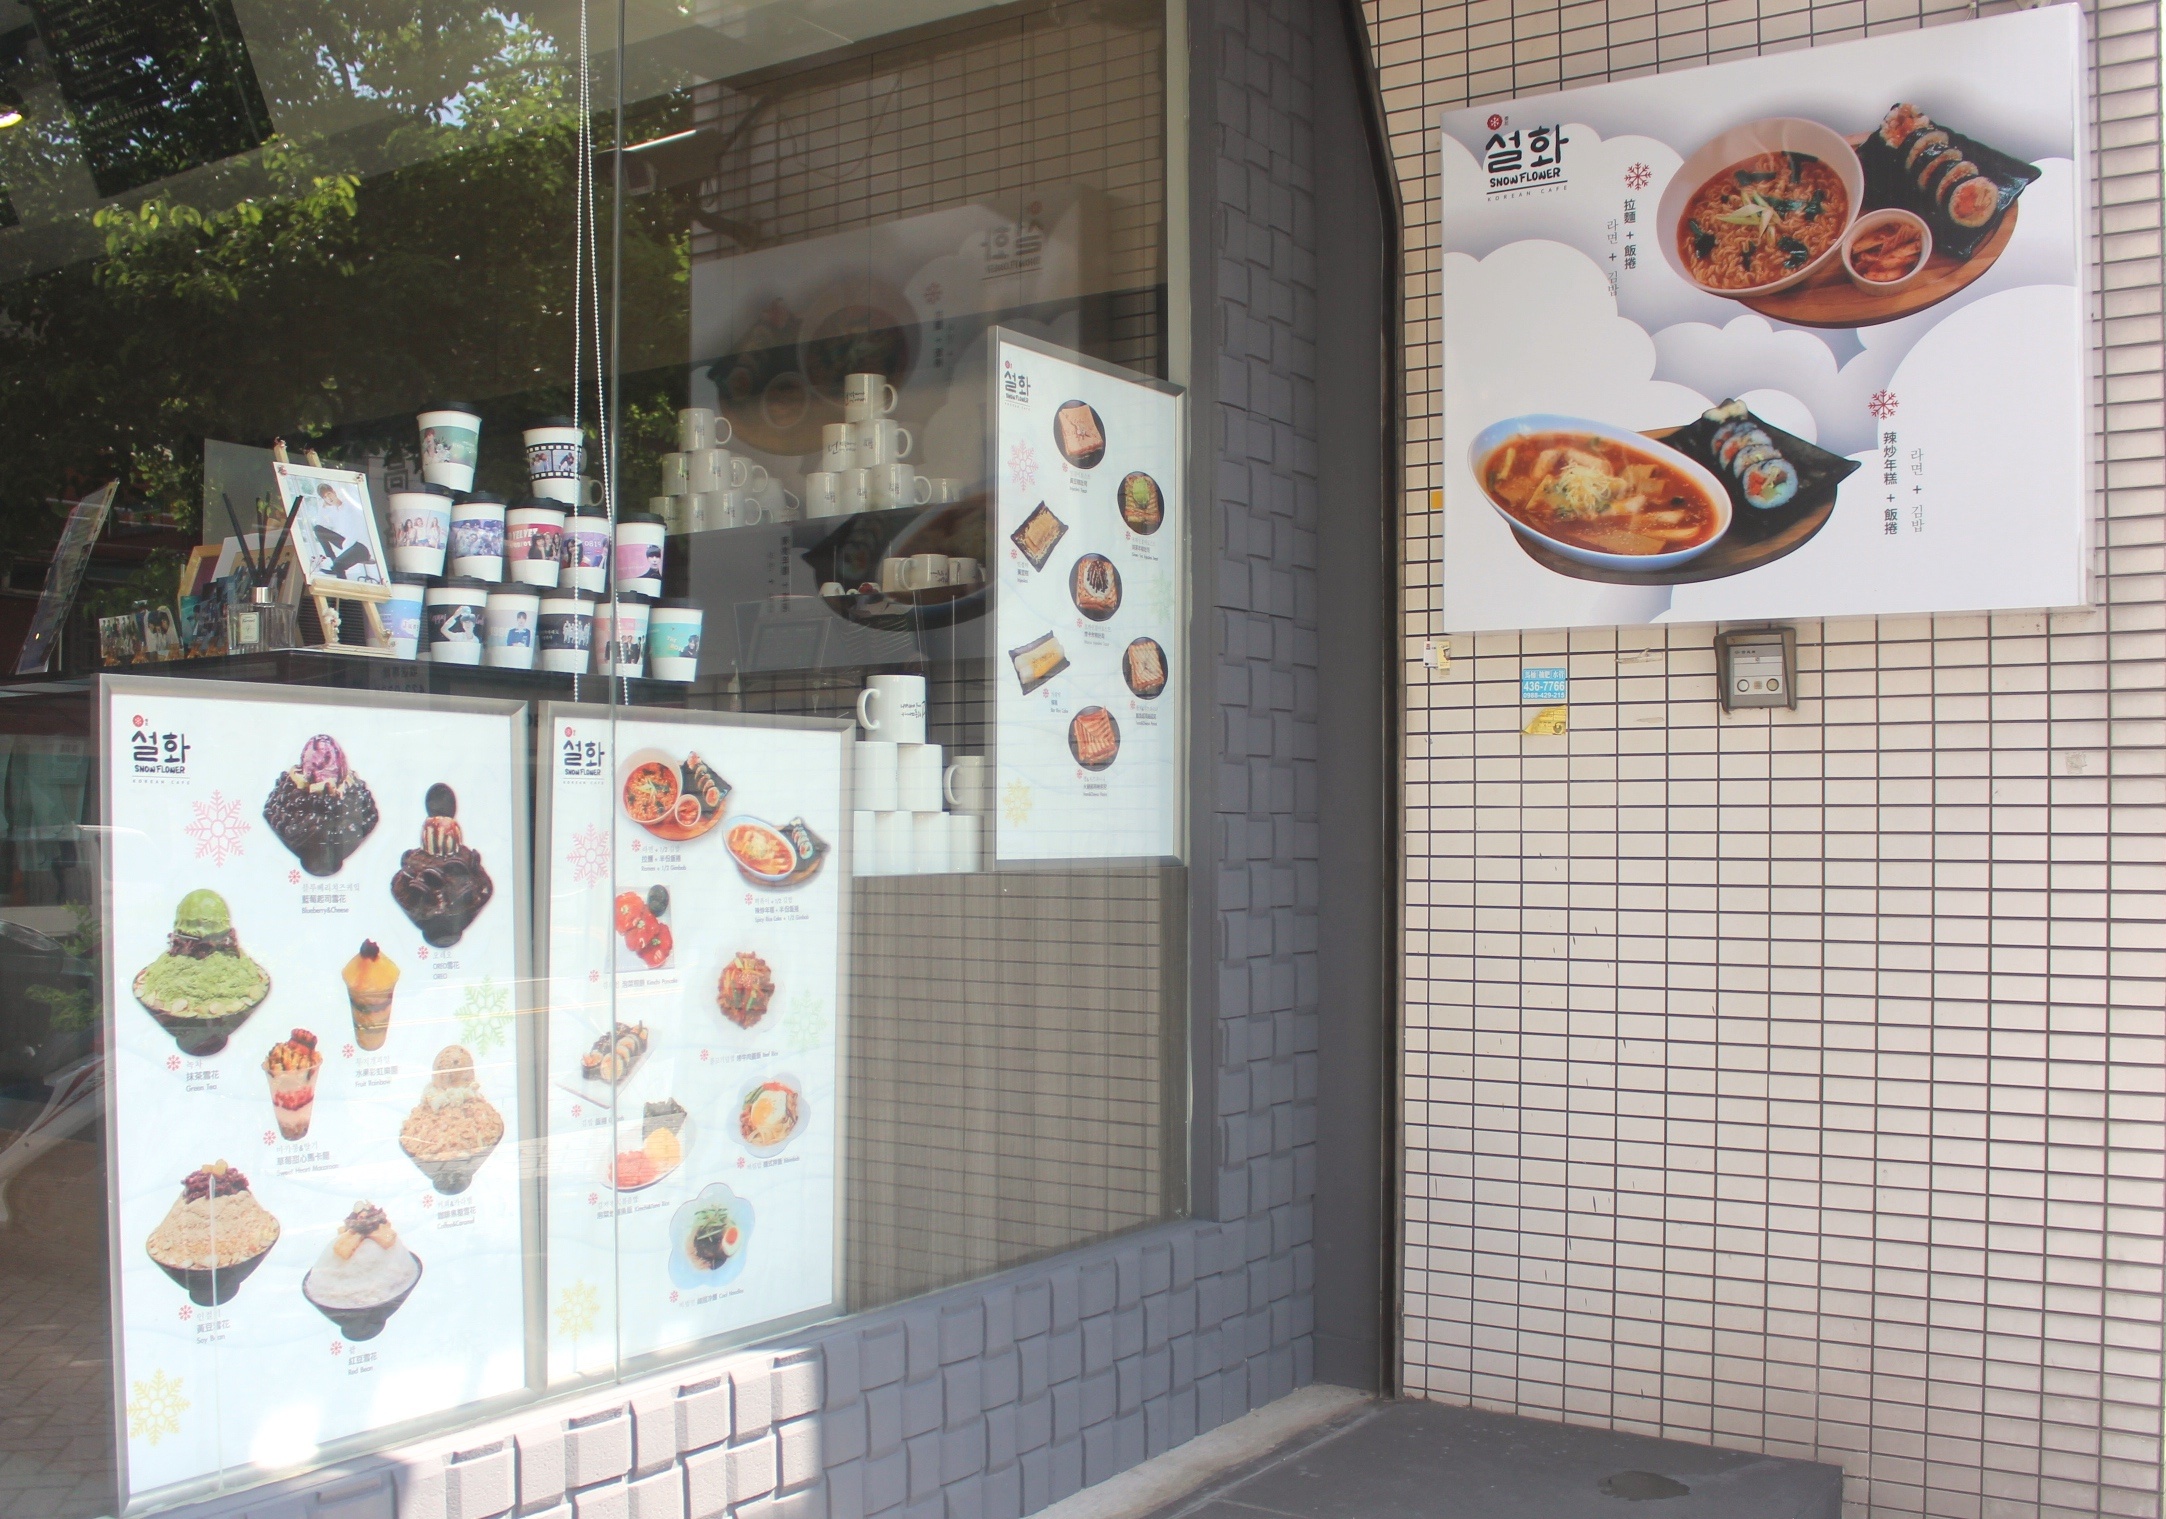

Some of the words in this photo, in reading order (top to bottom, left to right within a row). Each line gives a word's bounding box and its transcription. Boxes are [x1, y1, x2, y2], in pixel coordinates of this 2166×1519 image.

[1486, 124, 1569, 173] 설화
[1490, 175, 1519, 188] SNOW
[1519, 167, 1561, 183] FLOWER
[1487, 191, 1531, 202] KOREAN
[1541, 185, 1568, 195] CAFE
[1624, 199, 1636, 224] 拉麵
[1607, 219, 1618, 245] 라면
[1624, 244, 1637, 270] 飯捲
[1608, 270, 1620, 297] 김밥
[1004, 370, 1031, 397] 설화
[1883, 431, 1897, 486] 辣炒年糕
[1911, 448, 1924, 476] 라면
[1884, 508, 1898, 535] 飯捲
[1911, 504, 1925, 532] 김밥
[1523, 681, 1565, 691] 436-7766
[131, 730, 191, 764] 설화
[563, 739, 605, 767] 설화
[134, 764, 156, 773] SNOW
[156, 765, 186, 774] FLOWER
